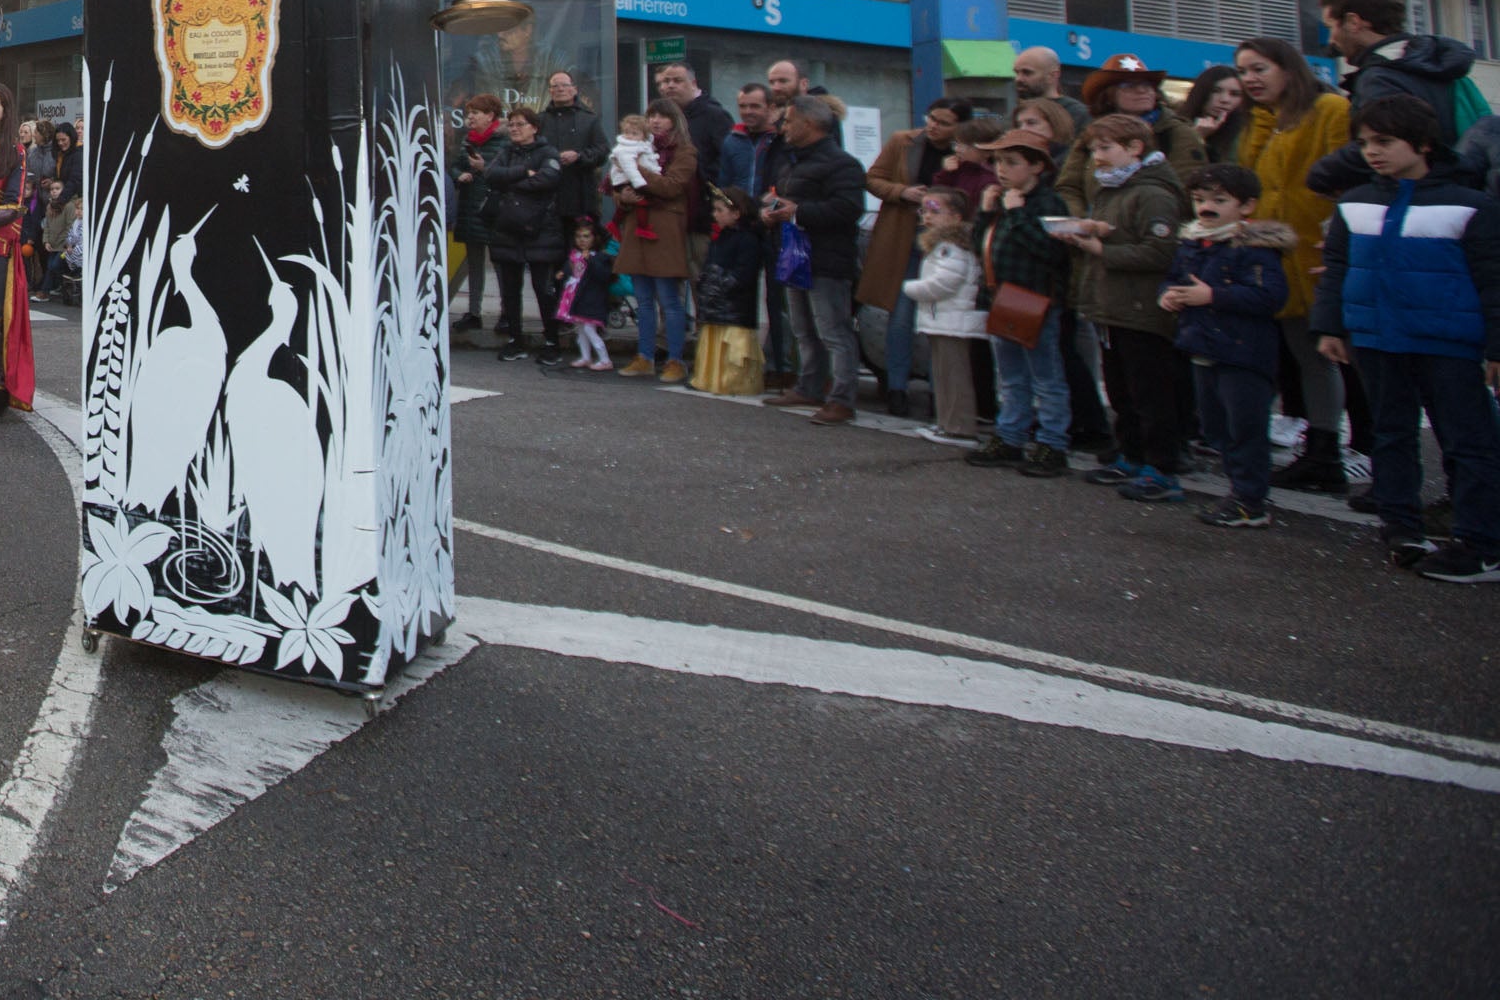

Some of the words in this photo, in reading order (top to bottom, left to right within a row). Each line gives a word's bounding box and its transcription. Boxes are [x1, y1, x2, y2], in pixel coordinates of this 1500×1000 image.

[1077, 35, 1092, 60] S
[504, 88, 540, 105] Dior
[38, 102, 66, 121] Negocio
